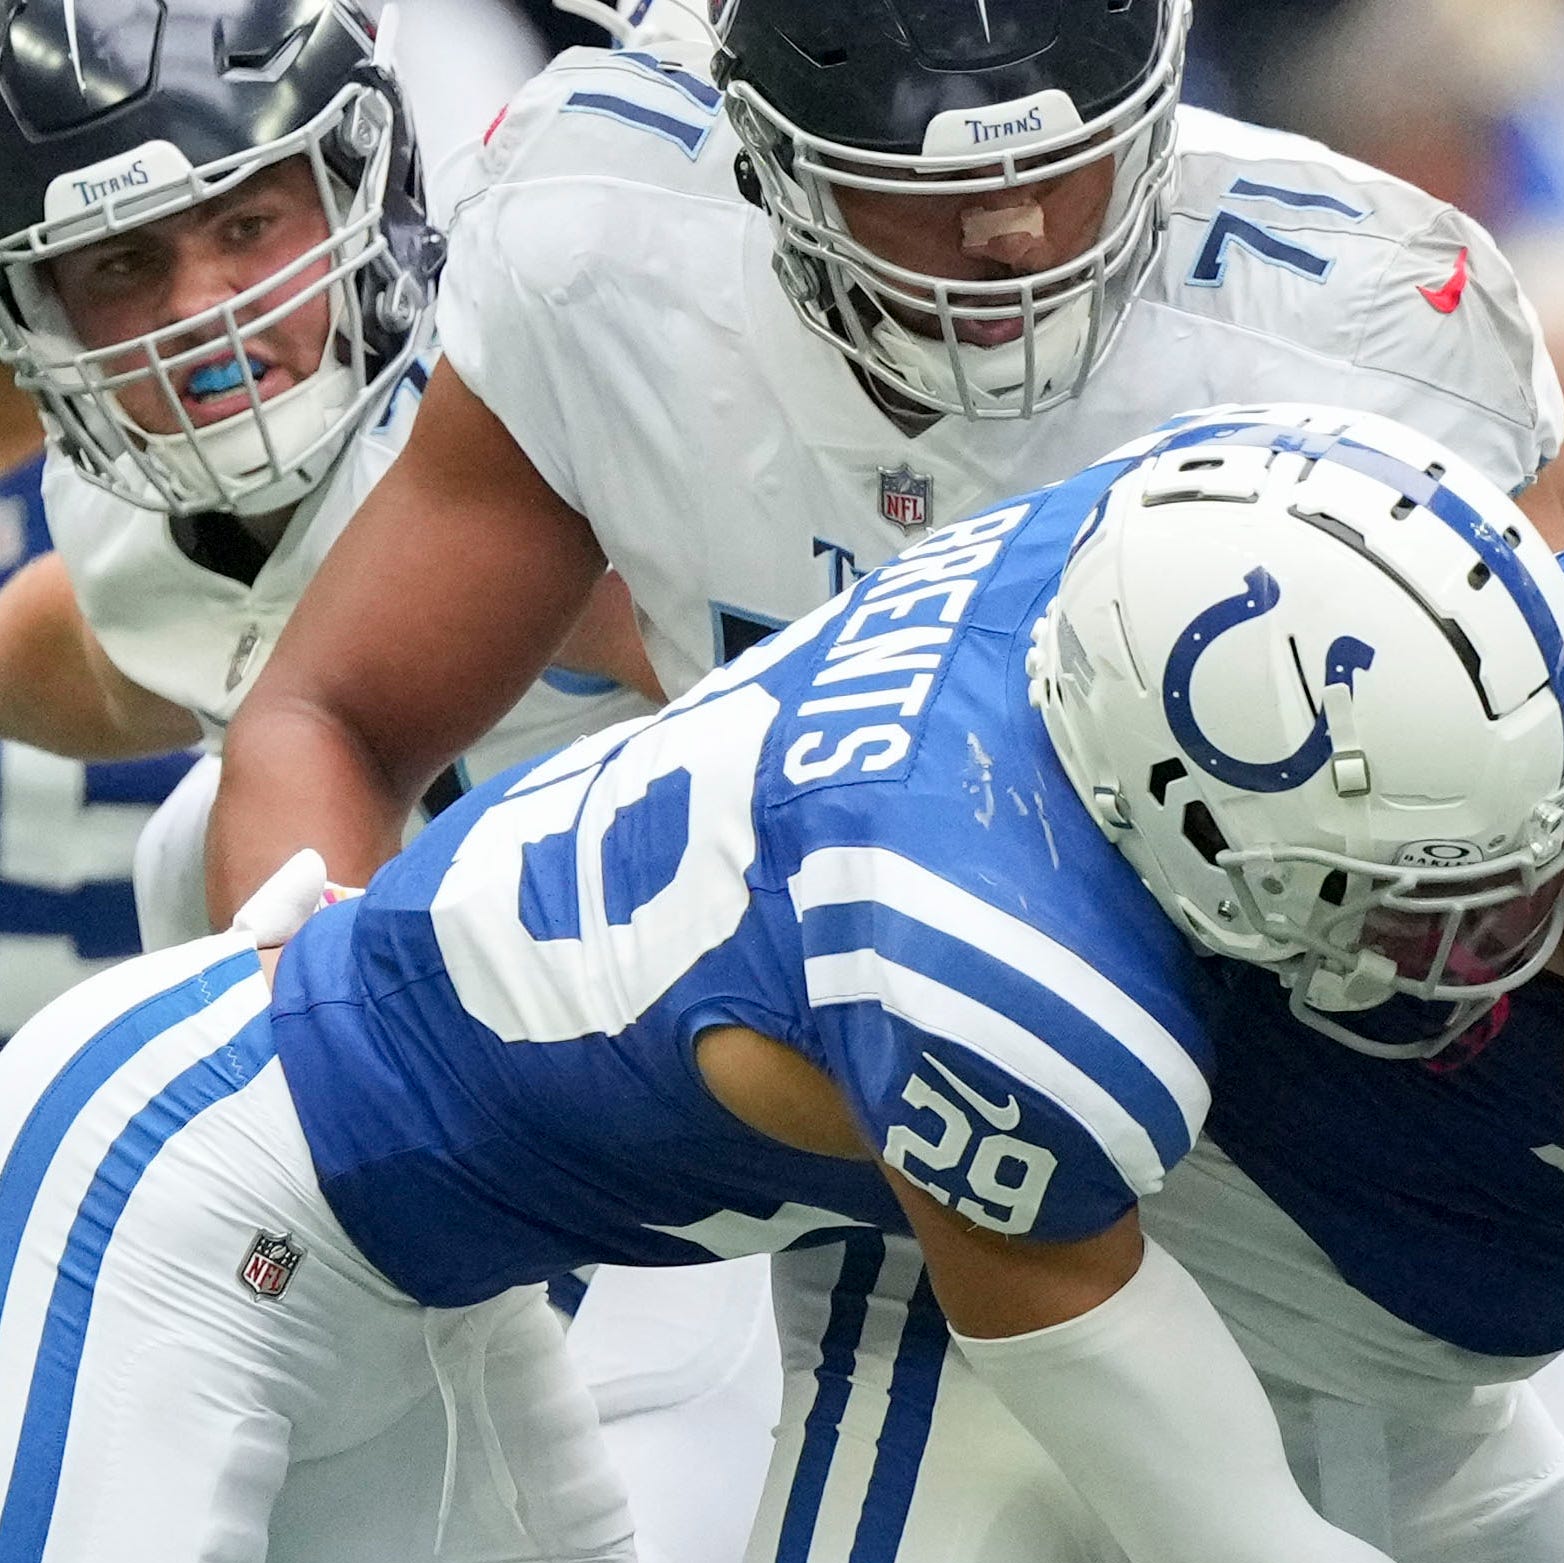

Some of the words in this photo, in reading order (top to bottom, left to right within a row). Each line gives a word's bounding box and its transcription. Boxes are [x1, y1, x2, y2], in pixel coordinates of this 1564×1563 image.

[1184, 176, 1376, 288] 71
[885, 494, 924, 522] NFL
[783, 502, 1031, 786] BRENTS
[882, 1072, 1059, 1236] 29
[245, 1255, 286, 1293] NFL
